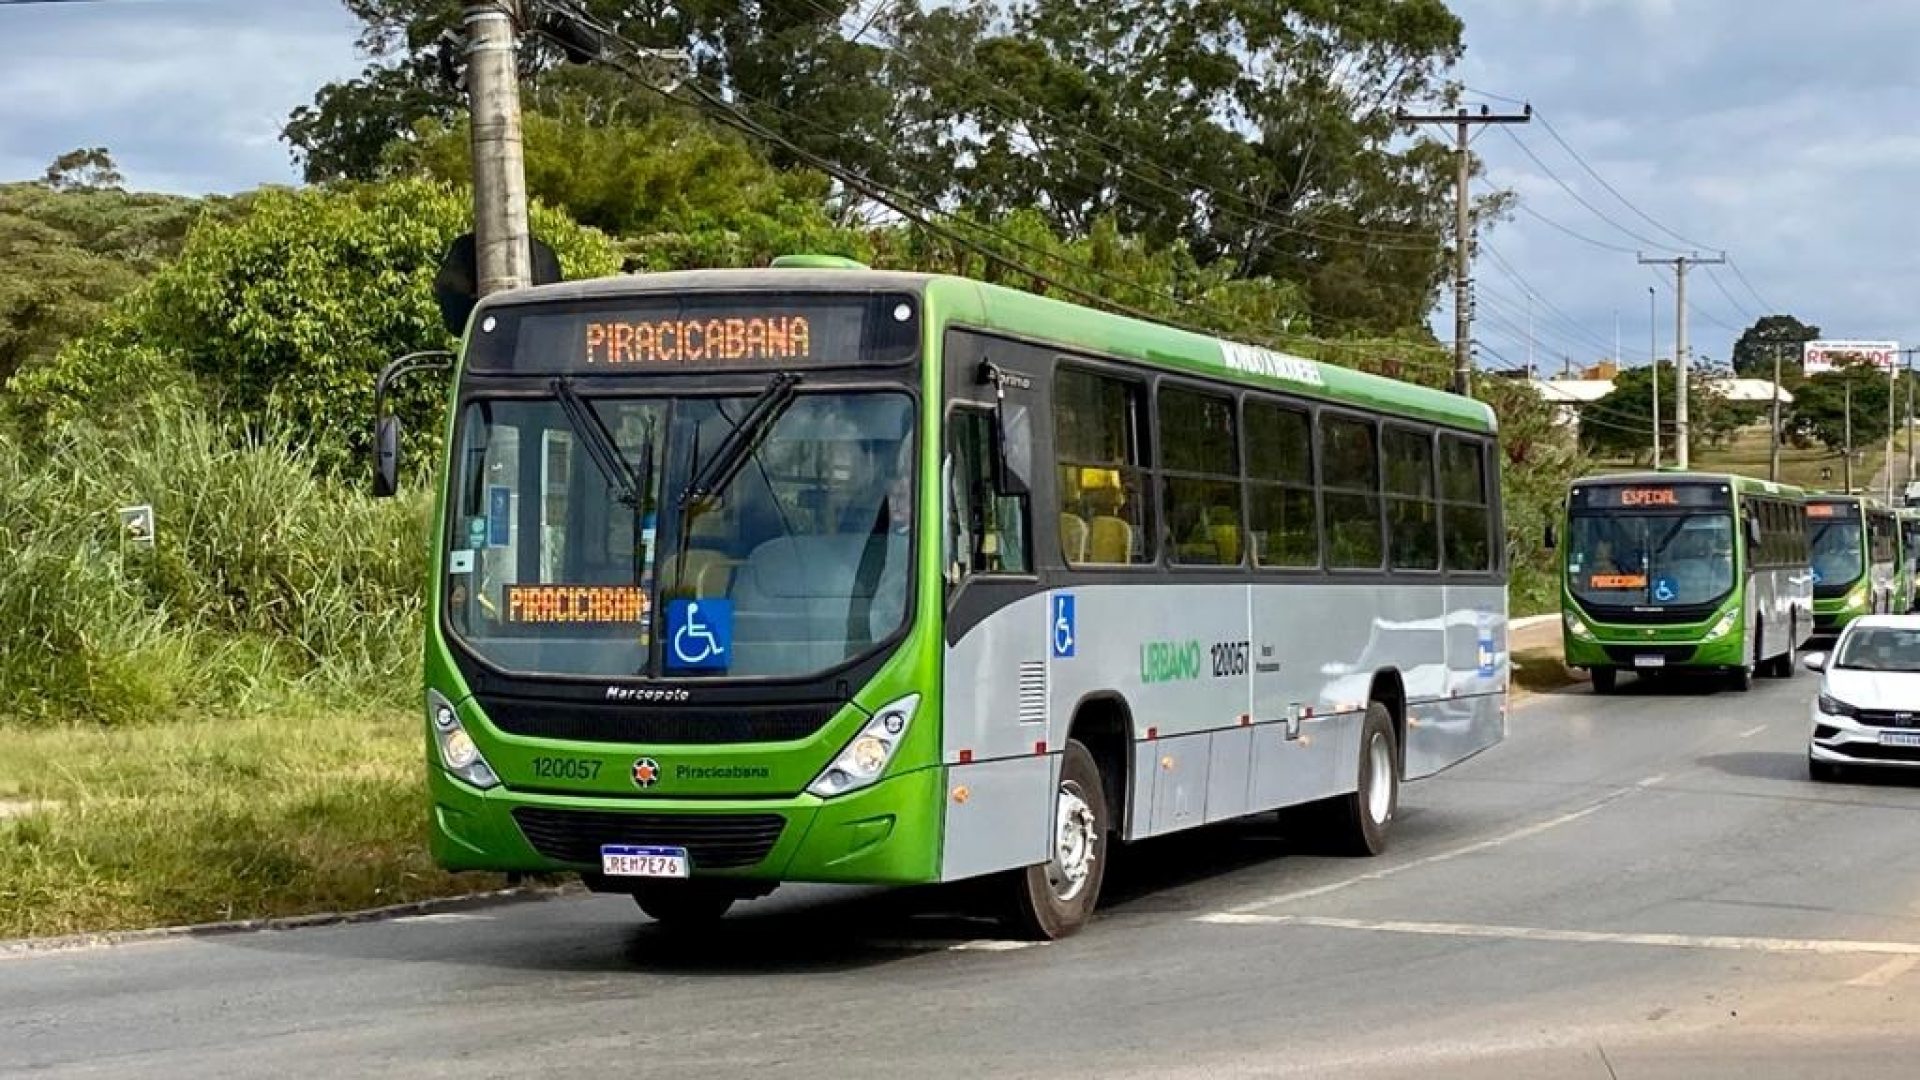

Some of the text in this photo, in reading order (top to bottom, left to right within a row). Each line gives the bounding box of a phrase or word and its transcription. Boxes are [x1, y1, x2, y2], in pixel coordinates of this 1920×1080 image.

[586, 316, 809, 363] PIRACICABANA
[509, 586, 645, 622] PIRACICABAN
[1140, 640, 1200, 683] URBANO
[1210, 640, 1249, 677] 120057
[606, 686, 690, 701] Marcopolo
[532, 758, 602, 780] 120057
[676, 764, 770, 778] Piracicabana
